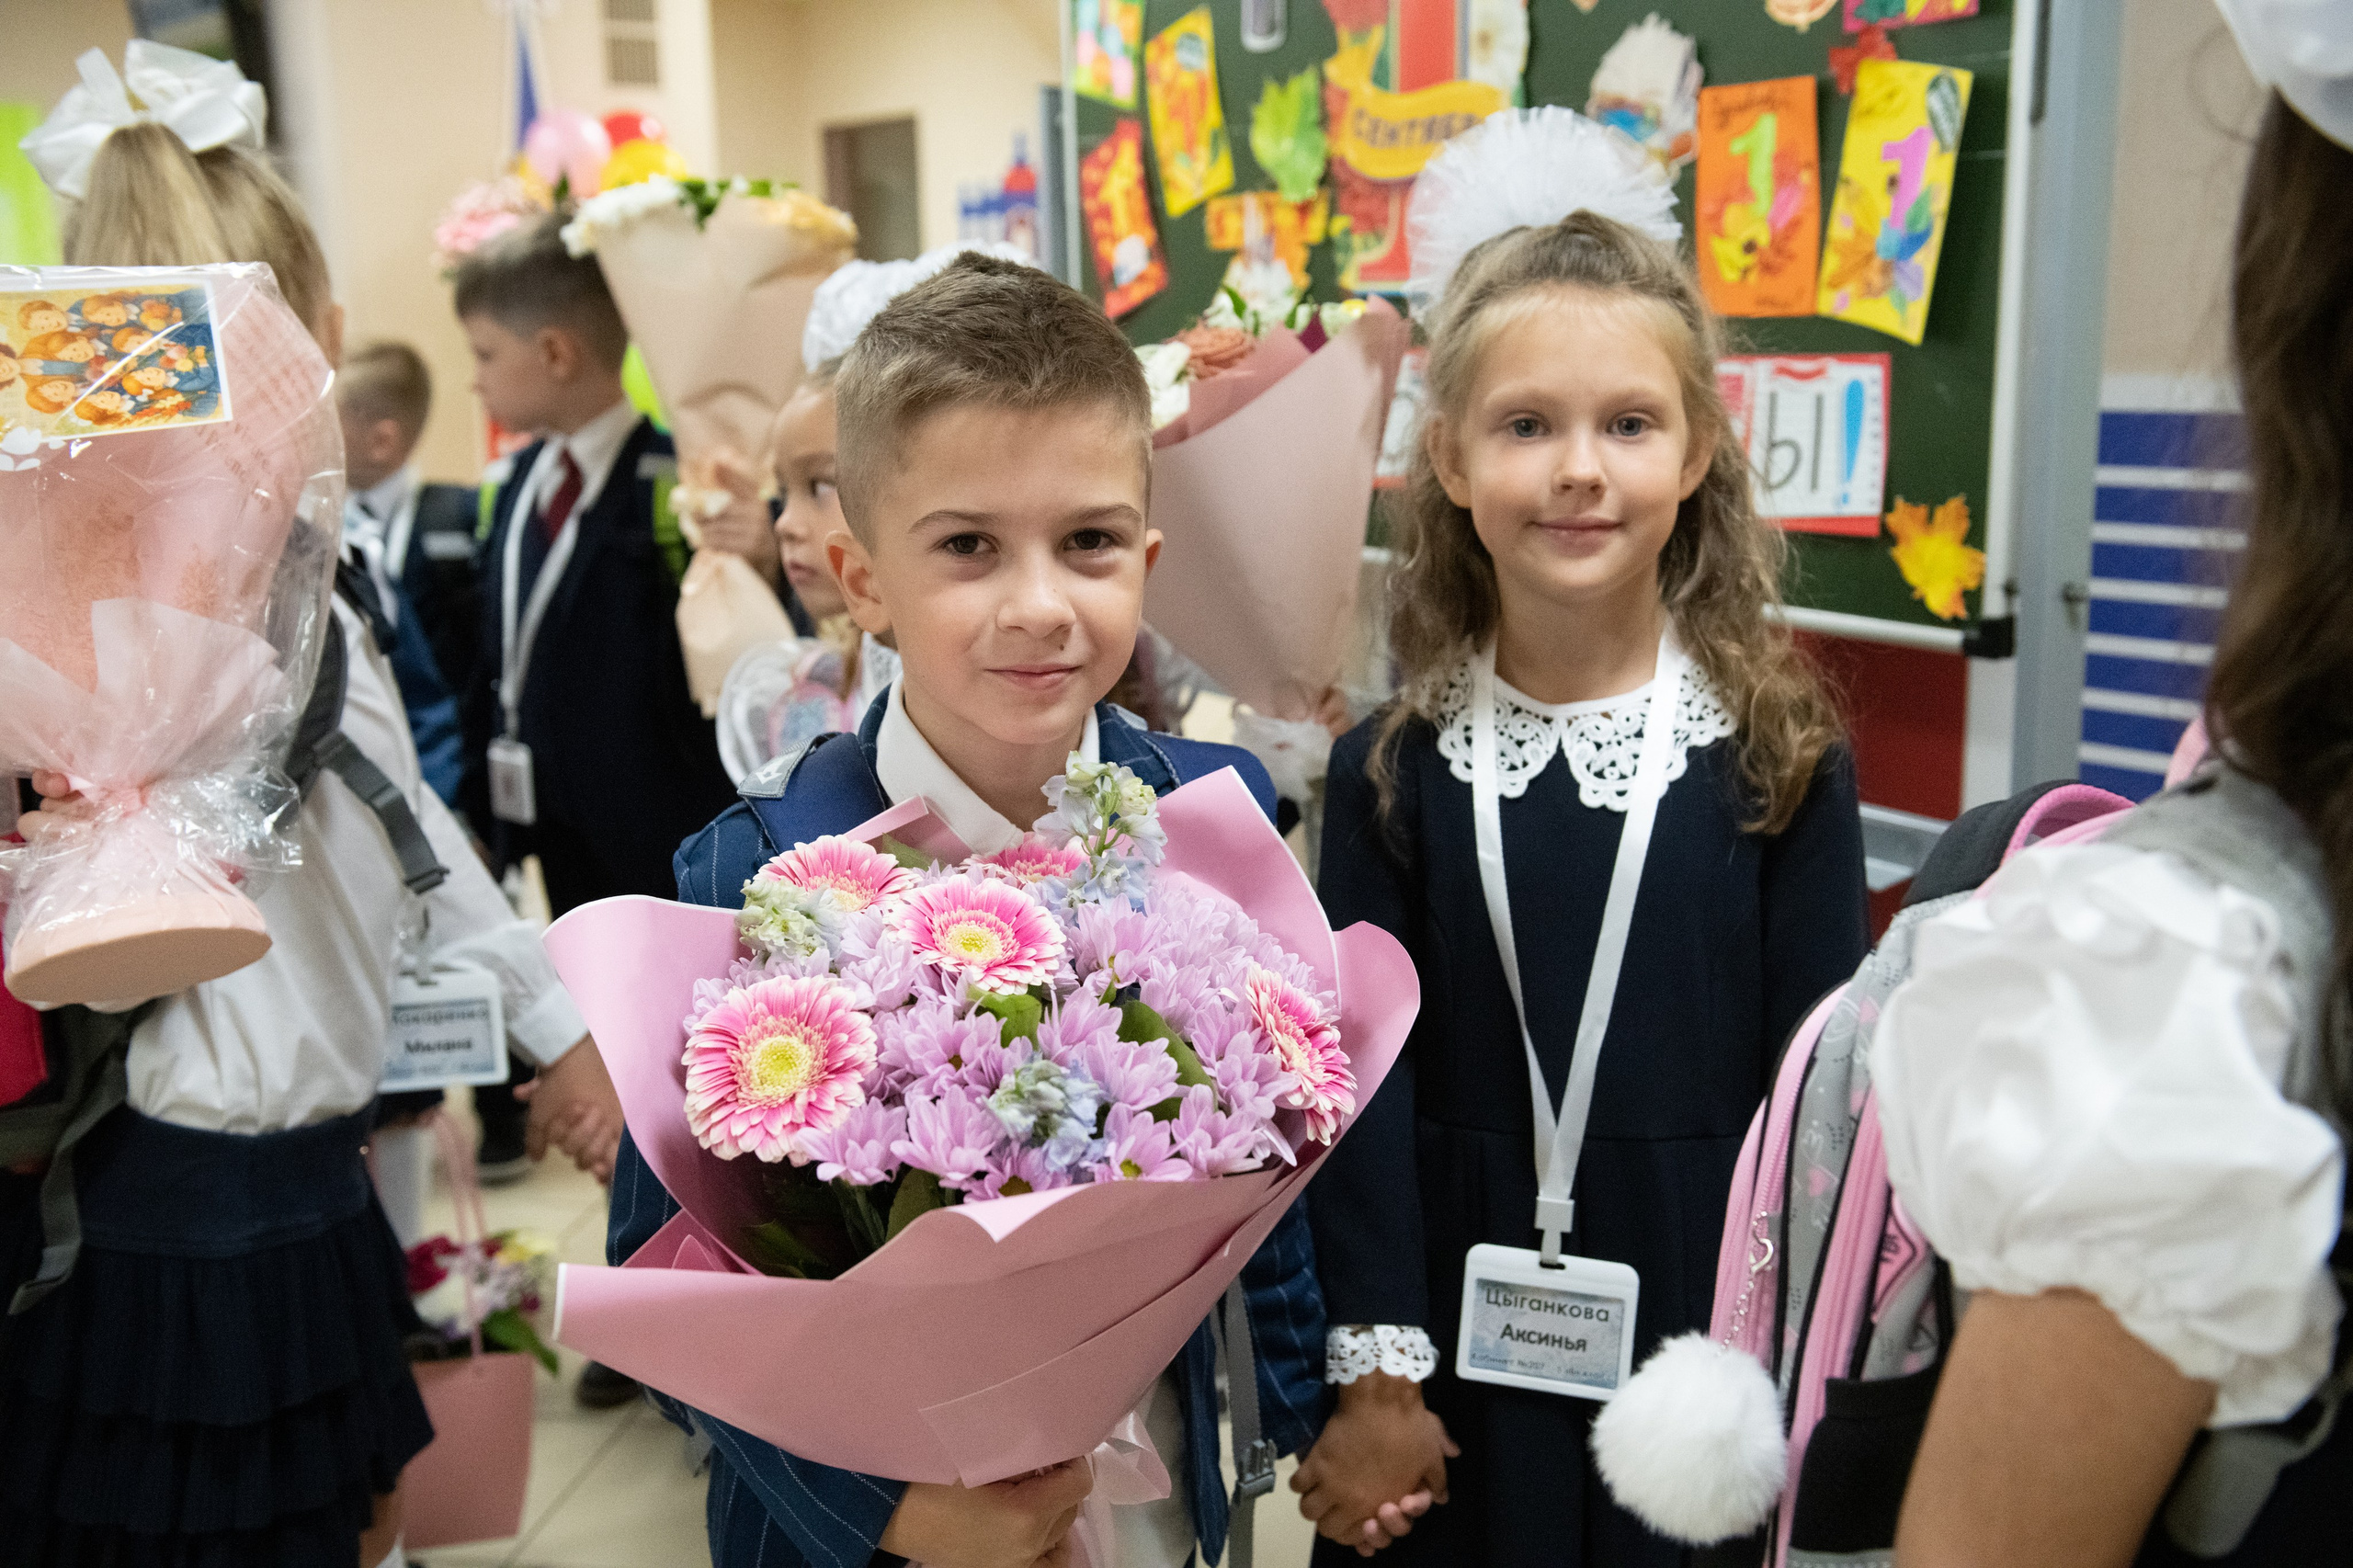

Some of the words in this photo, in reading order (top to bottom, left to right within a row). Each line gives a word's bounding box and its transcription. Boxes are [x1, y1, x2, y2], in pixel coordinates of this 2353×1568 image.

[1730, 112, 1777, 221] 1
[1881, 126, 1934, 230] 1
[1485, 1287, 1609, 1323] Цыганкова
[1499, 1323, 1587, 1352] Аксинья
